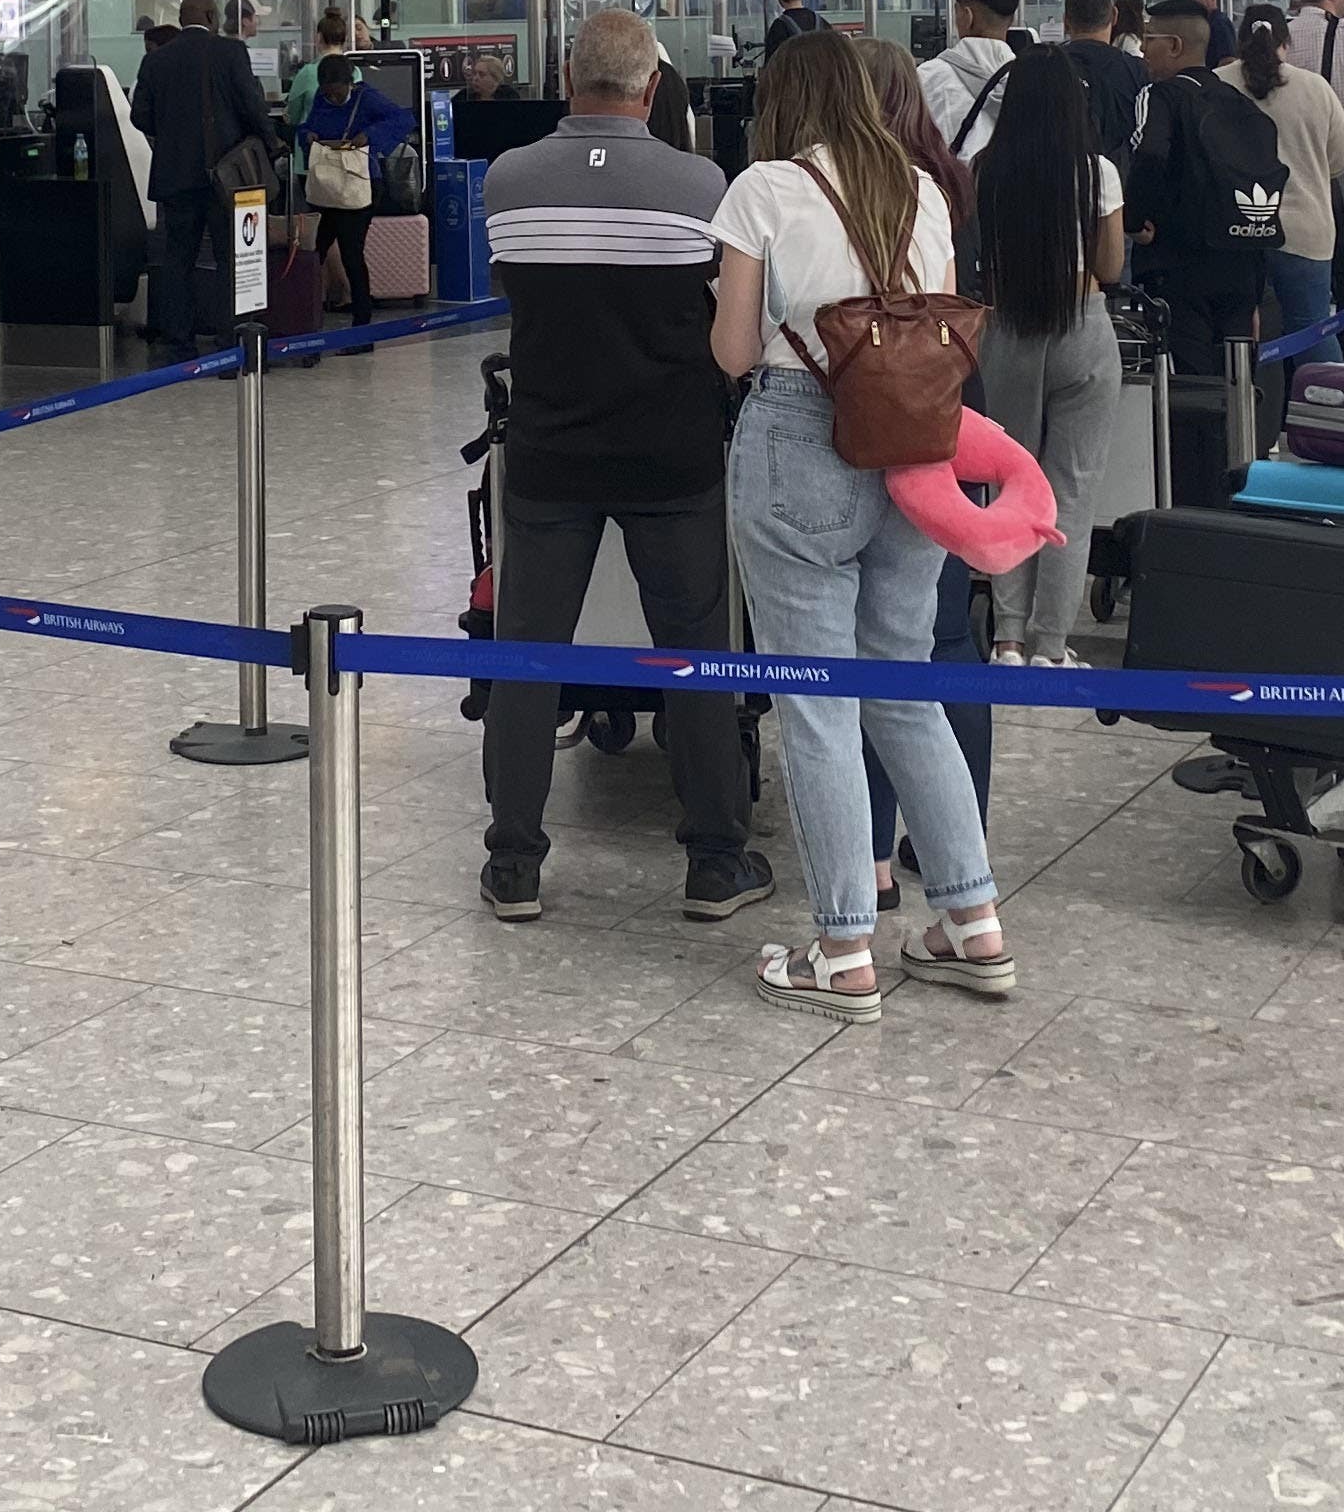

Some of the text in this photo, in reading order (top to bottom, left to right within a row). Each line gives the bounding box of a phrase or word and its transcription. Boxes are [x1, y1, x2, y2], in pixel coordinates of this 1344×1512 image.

[1229, 221, 1277, 239] adidas
[43, 613, 125, 635] BRITISH AIRWAYS
[700, 661, 830, 683] BRITISH AIRWAYS
[1260, 685, 1326, 702] BRITISH
